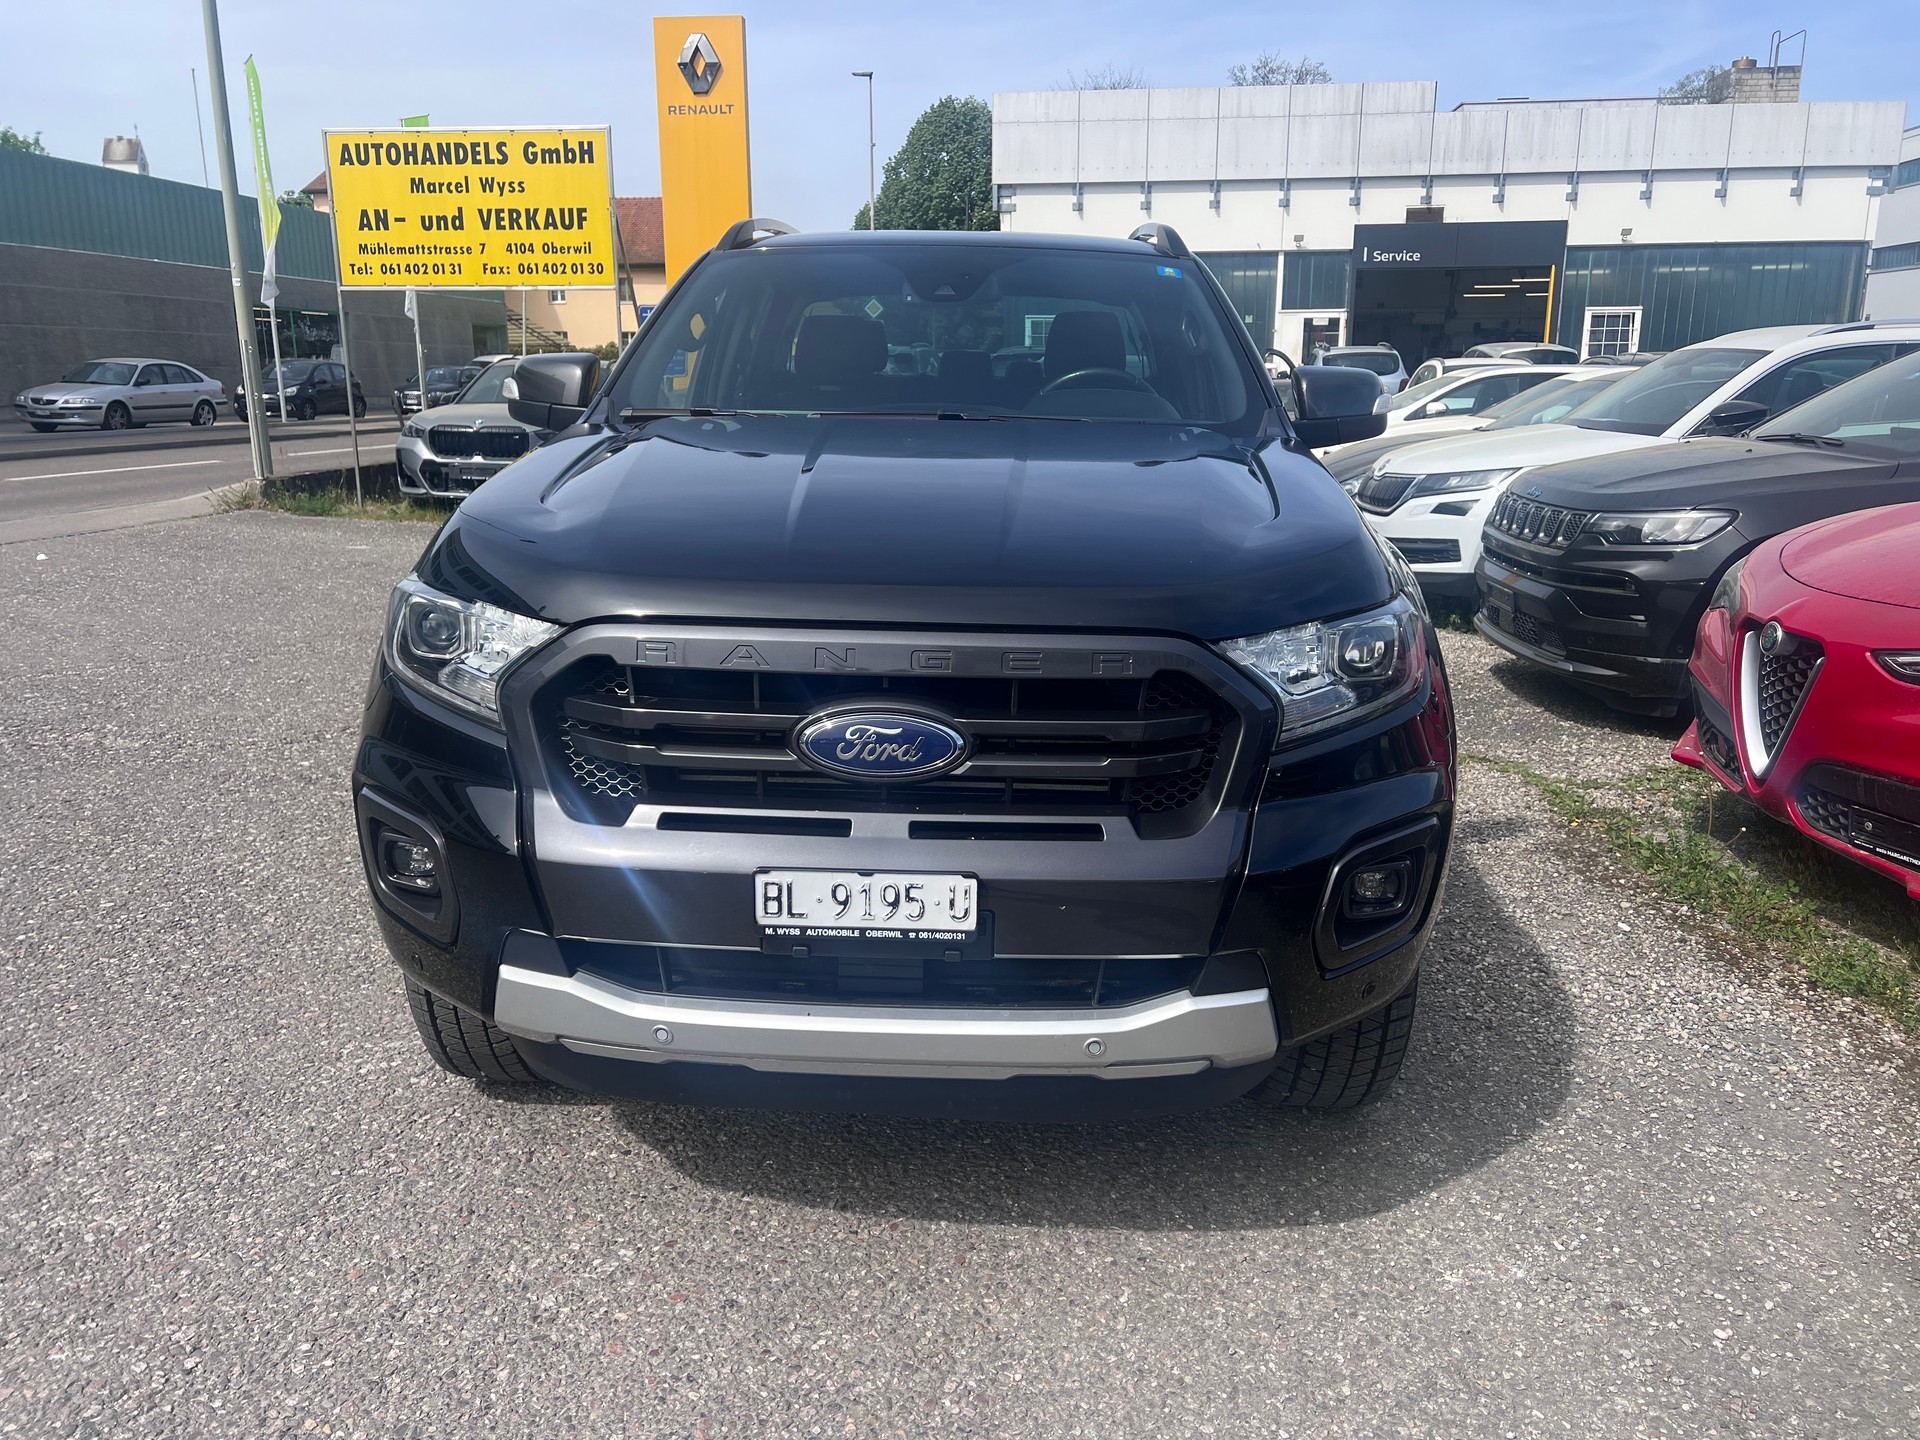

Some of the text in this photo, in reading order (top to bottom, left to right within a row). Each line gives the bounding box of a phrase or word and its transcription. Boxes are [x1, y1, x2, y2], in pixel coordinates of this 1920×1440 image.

[668, 104, 734, 115] RENAULT
[339, 140, 595, 166] AUTOHANDELS GmbH
[410, 176, 526, 197] Marcel Wyss
[421, 206, 465, 231] und
[478, 207, 589, 230] VERKAUF
[358, 242, 592, 255] Mühlemattstrasse 7 4104 Oberwil
[1373, 250, 1421, 262] Service
[349, 263, 373, 275] Tel:
[482, 263, 511, 275] Fax:
[636, 640, 1135, 675] RANGER
[836, 725, 925, 763] Ford
[762, 879, 971, 923] BL 9195 U
[777, 928, 800, 936] WYSS
[806, 929, 860, 937] AUTOMOBILE
[865, 930, 903, 938] OBERWIL
[919, 932, 966, 940] 061/4020131
